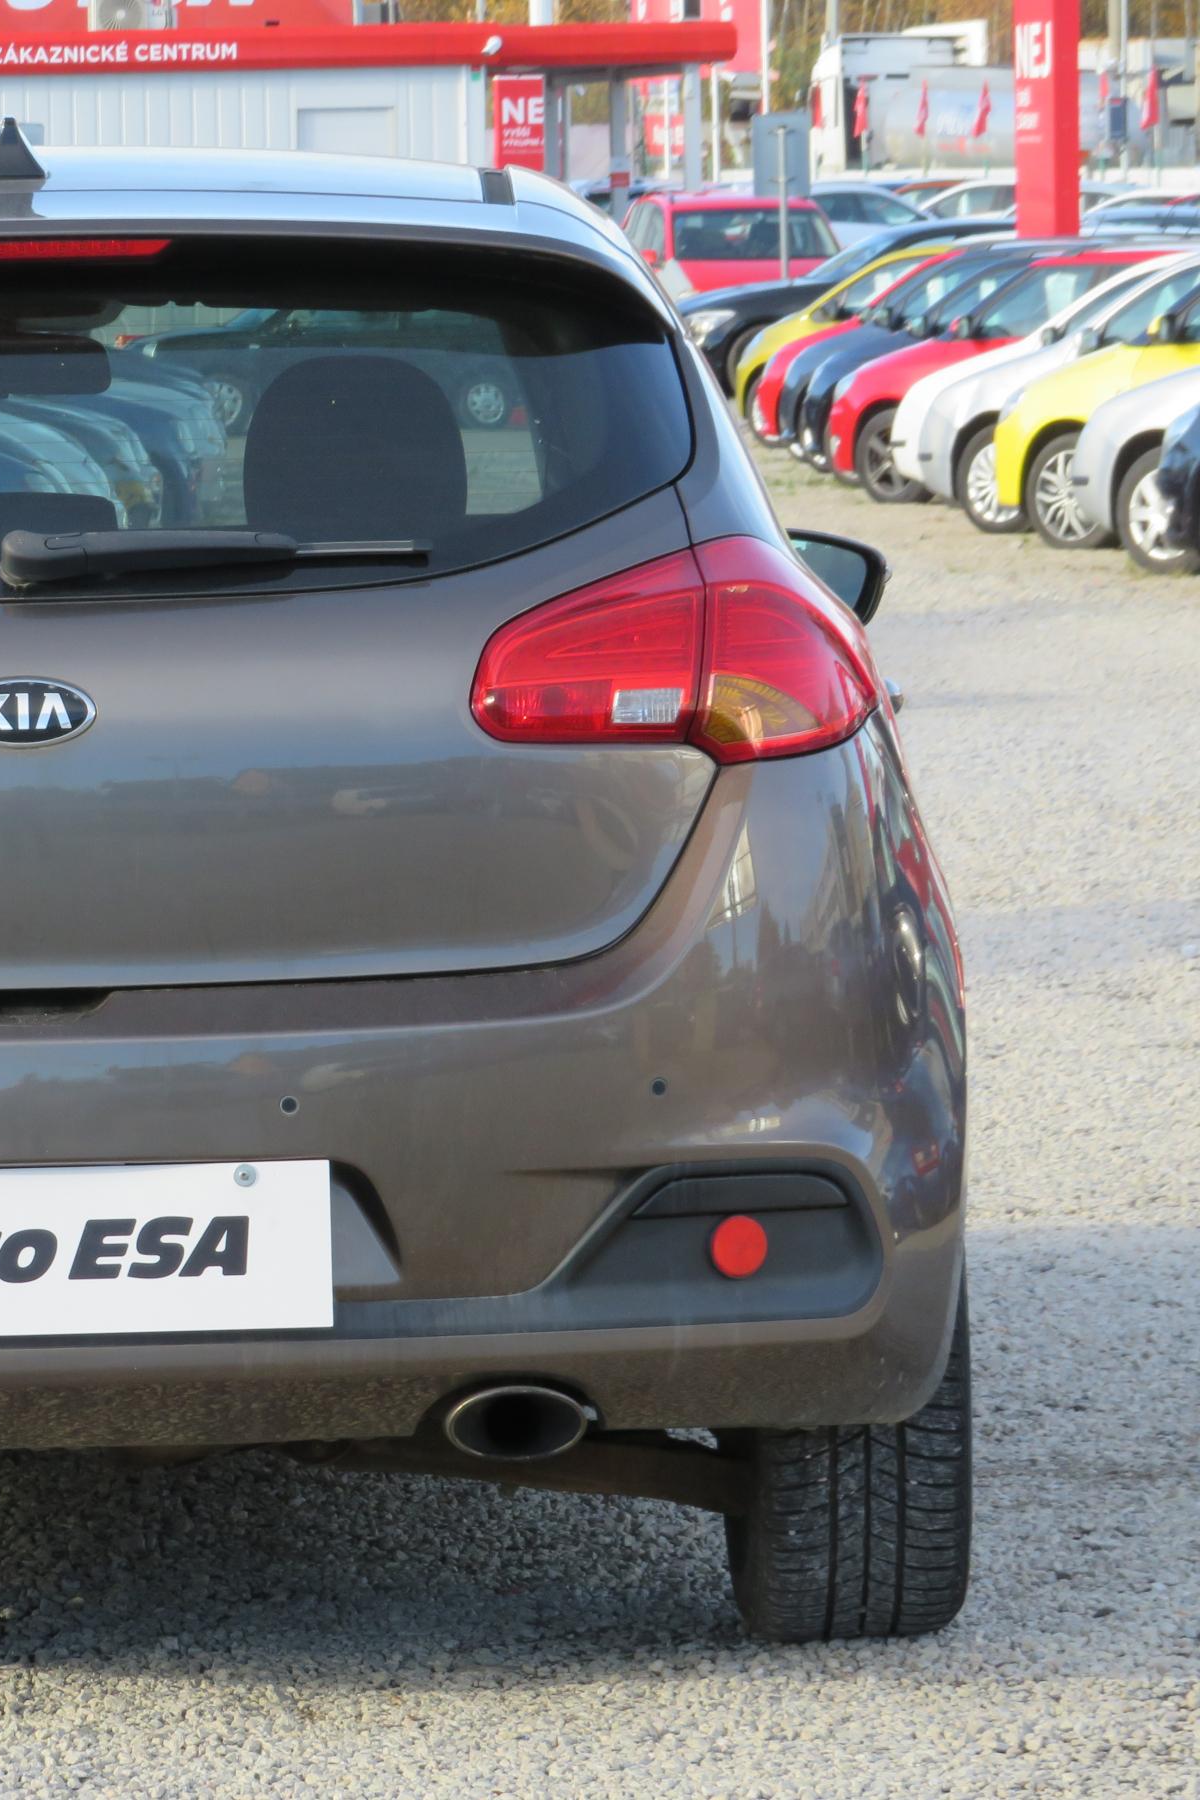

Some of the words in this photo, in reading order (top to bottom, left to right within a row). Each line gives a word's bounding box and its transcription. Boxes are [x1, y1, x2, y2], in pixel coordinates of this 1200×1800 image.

[134, 43, 237, 62] CENTRUM
[1015, 21, 1052, 79] NEJ
[68, 1215, 250, 1281] ESA
